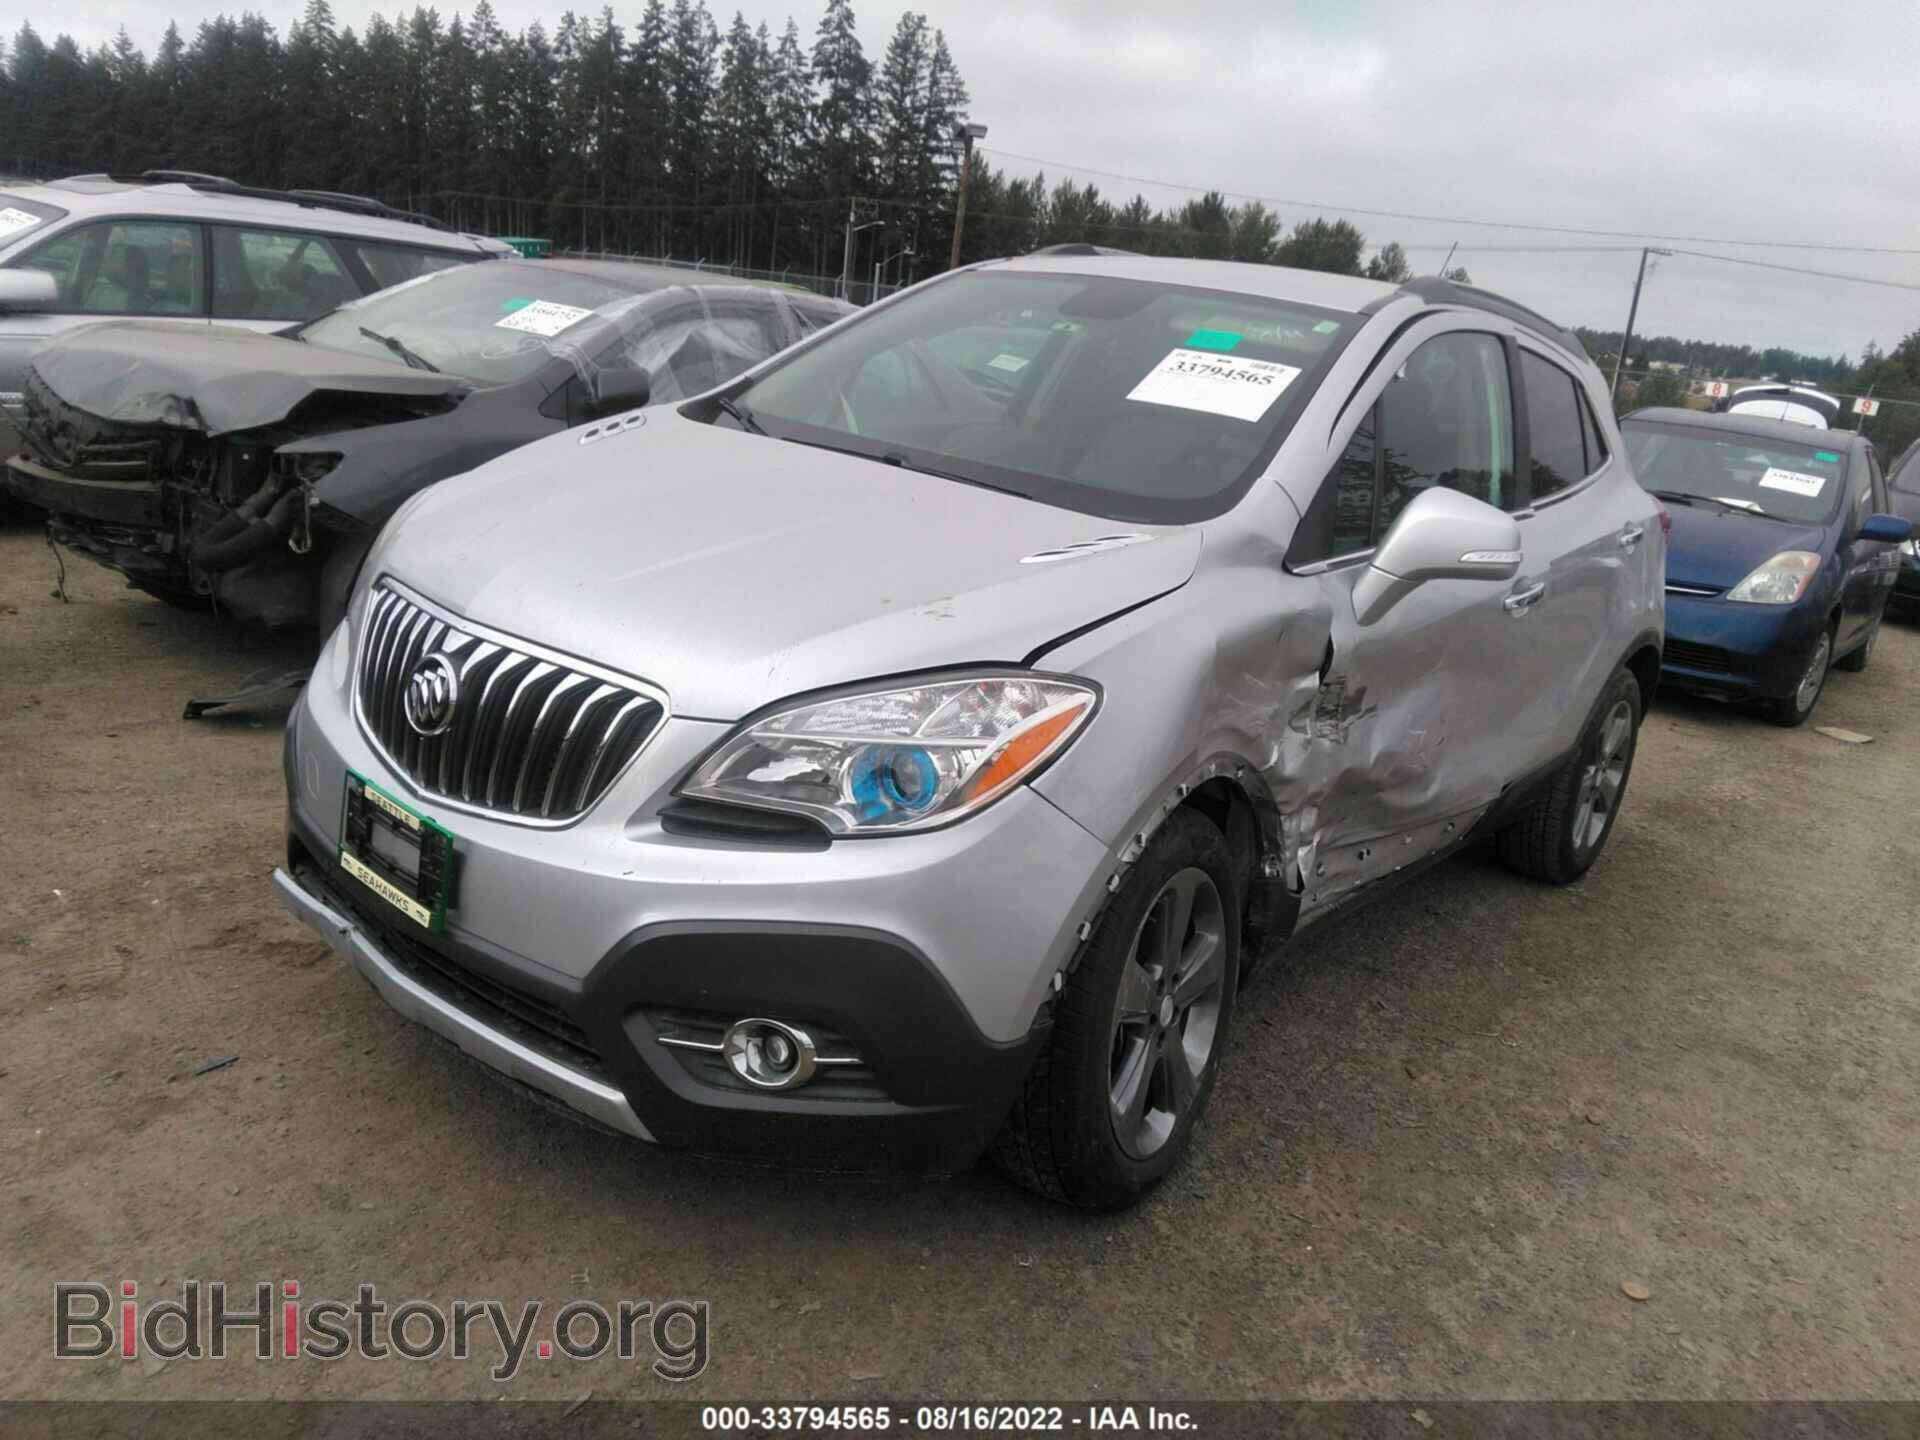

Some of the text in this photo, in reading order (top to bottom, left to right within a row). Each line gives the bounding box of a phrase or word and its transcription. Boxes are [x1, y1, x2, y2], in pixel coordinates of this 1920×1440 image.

[1169, 360, 1276, 386] 33794565
[1712, 383, 1722, 396] 8
[1861, 399, 1873, 414] 9
[356, 866, 410, 913] SEAHAWKS
